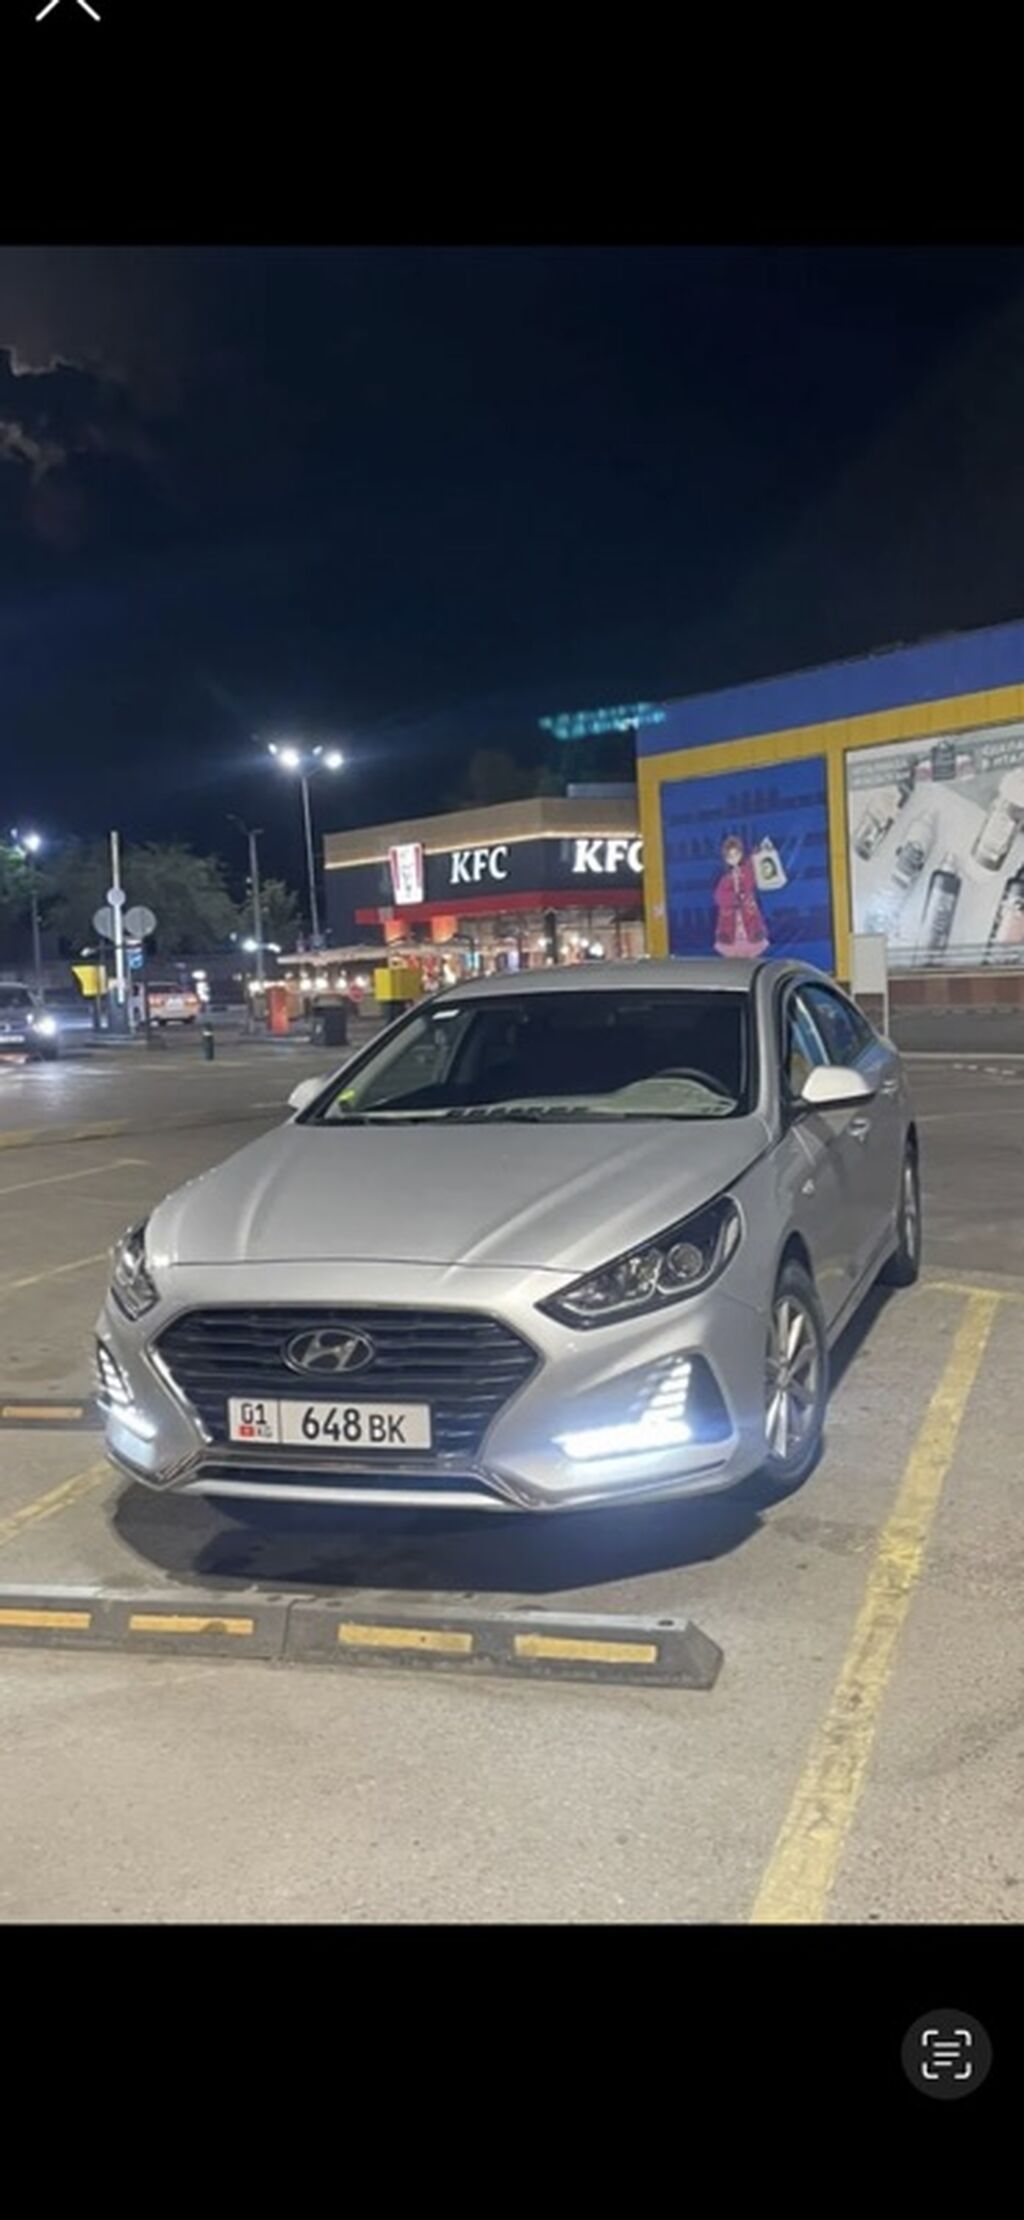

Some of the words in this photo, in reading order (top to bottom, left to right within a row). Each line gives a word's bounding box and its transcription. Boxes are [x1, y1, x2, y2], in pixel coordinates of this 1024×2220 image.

[450, 846, 507, 884] KFC
[572, 840, 644, 872] KFC
[241, 1403, 267, 1425] 01
[302, 1406, 362, 1441] 648
[368, 1414, 406, 1443] BK
